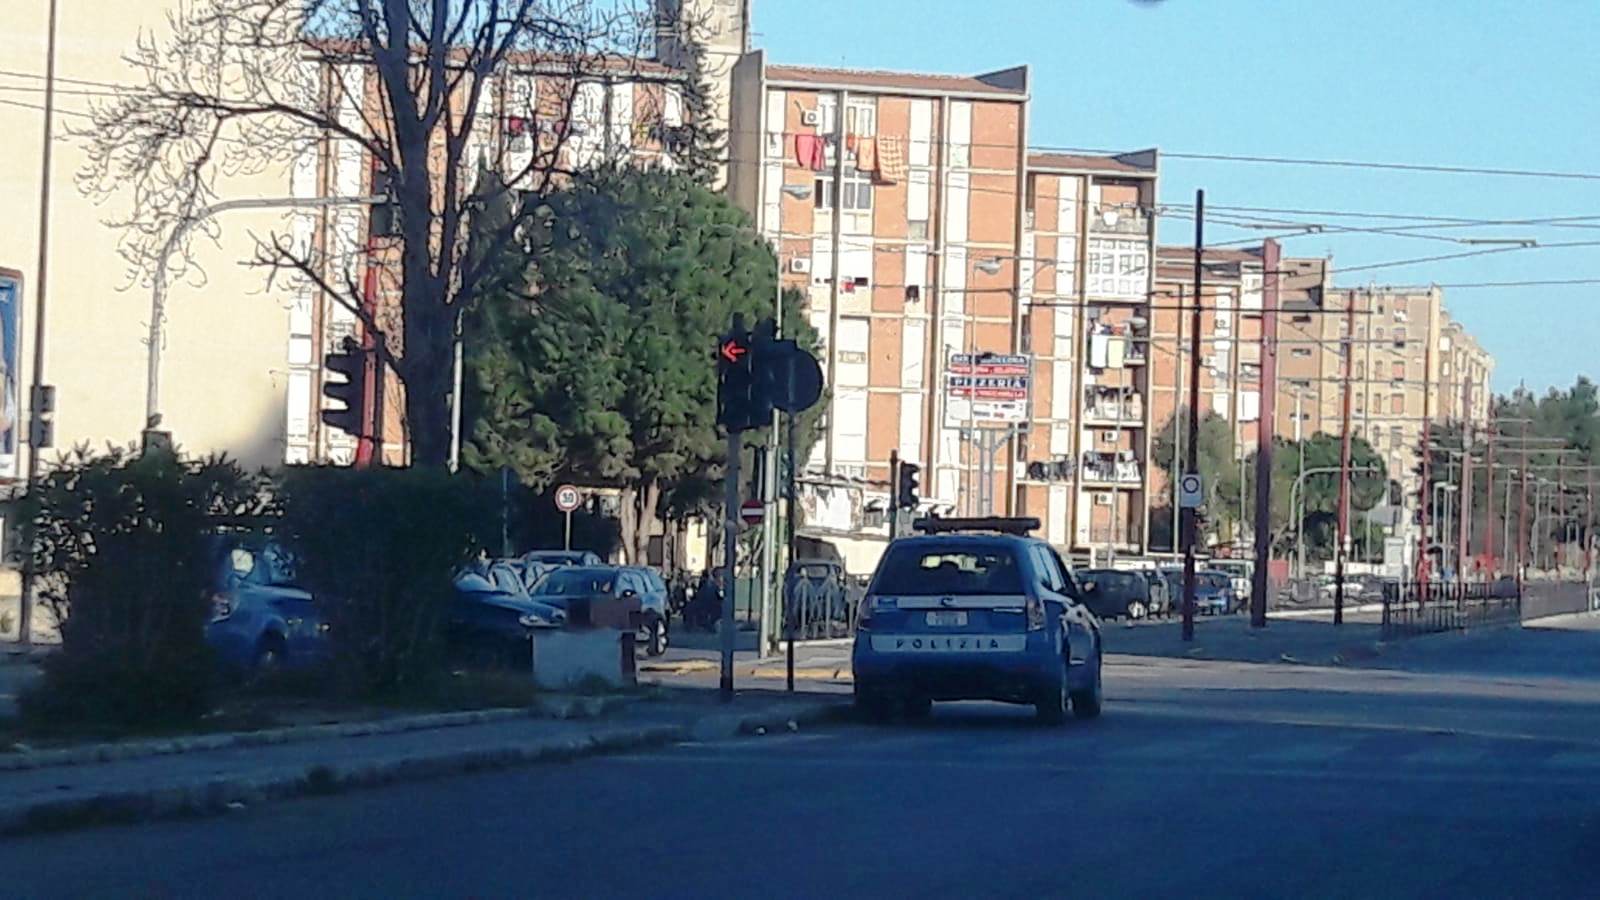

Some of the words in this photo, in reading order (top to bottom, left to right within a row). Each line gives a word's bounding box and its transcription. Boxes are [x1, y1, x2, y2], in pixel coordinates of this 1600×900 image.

[955, 377, 1022, 389] PIZERIA
[561, 492, 574, 503] 30
[896, 639, 999, 649] POLIZIA
